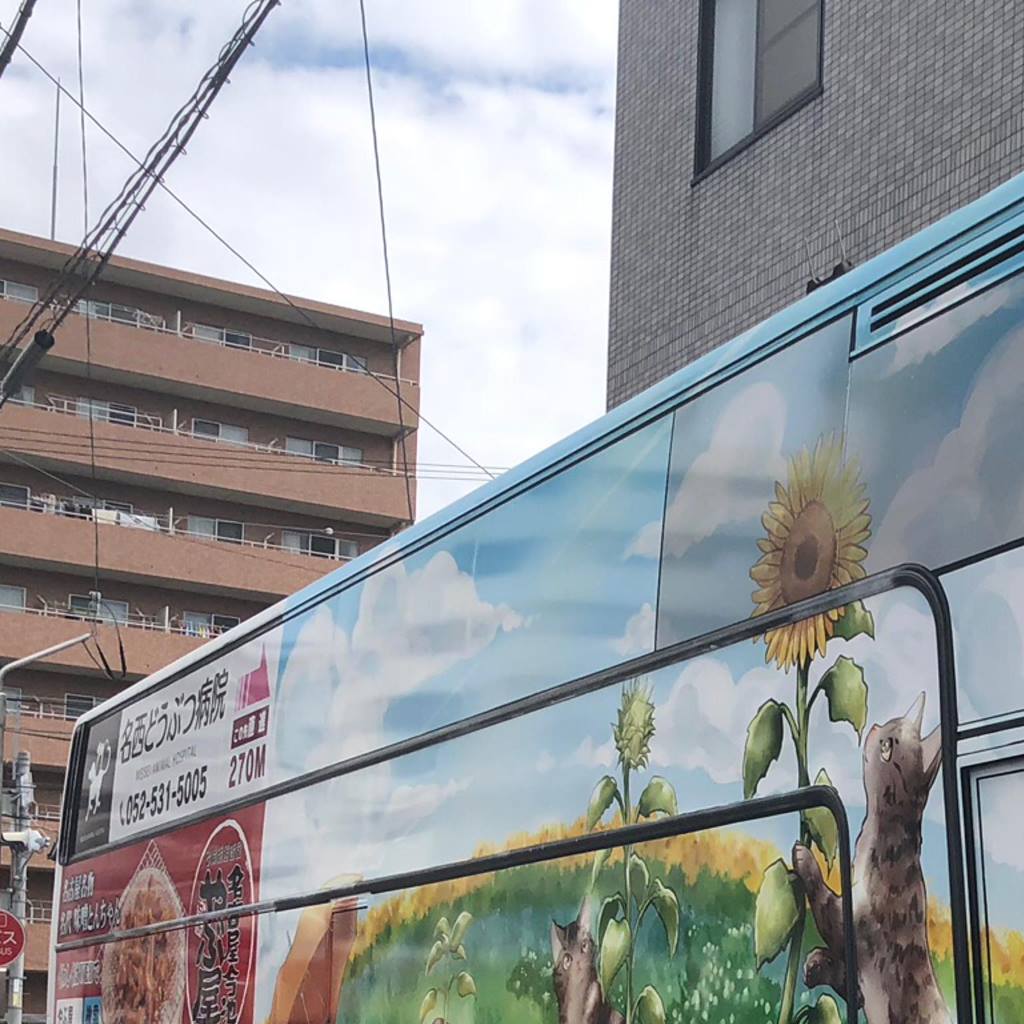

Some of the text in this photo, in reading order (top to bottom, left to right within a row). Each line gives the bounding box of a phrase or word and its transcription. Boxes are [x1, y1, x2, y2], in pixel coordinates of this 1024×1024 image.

[120, 668, 229, 764] 名西どうぶつ病院
[228, 744, 266, 788] 270M
[126, 765, 208, 826] 052-531-5005
[0, 930, 17, 945] ス
